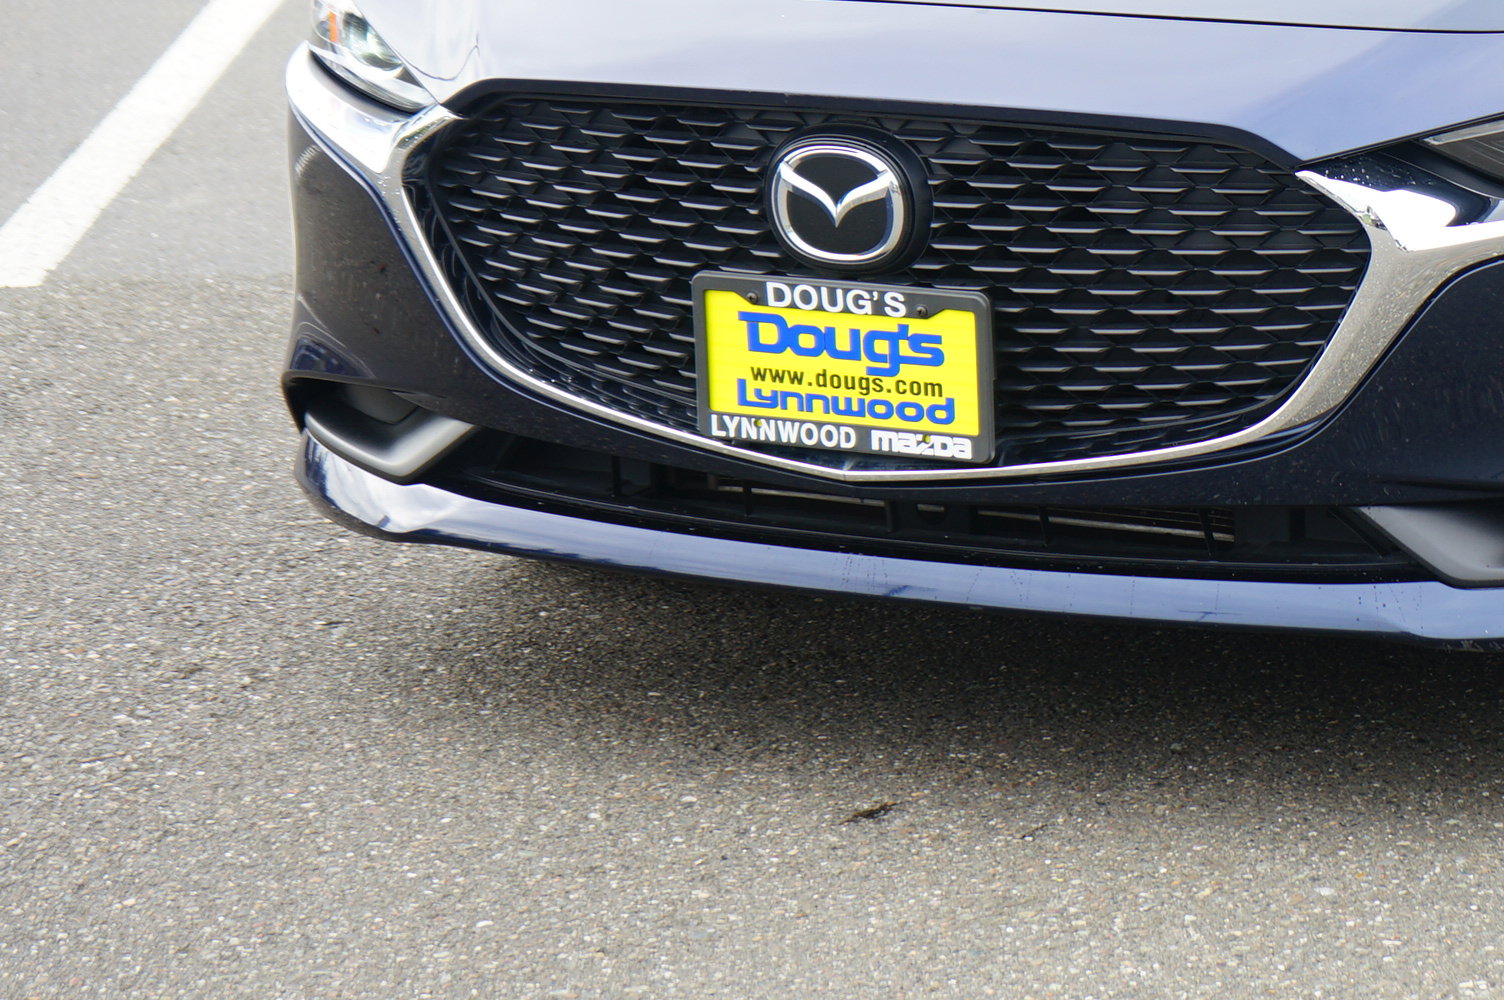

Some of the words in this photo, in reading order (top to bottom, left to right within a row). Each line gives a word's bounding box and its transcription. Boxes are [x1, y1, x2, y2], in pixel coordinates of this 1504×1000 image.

[765, 281, 907, 317] DOUG'S
[737, 310, 945, 378] Doug's
[750, 366, 943, 397] www.dougs.com
[736, 378, 956, 426] Lynnwood
[710, 413, 857, 450] LYNNWOOD
